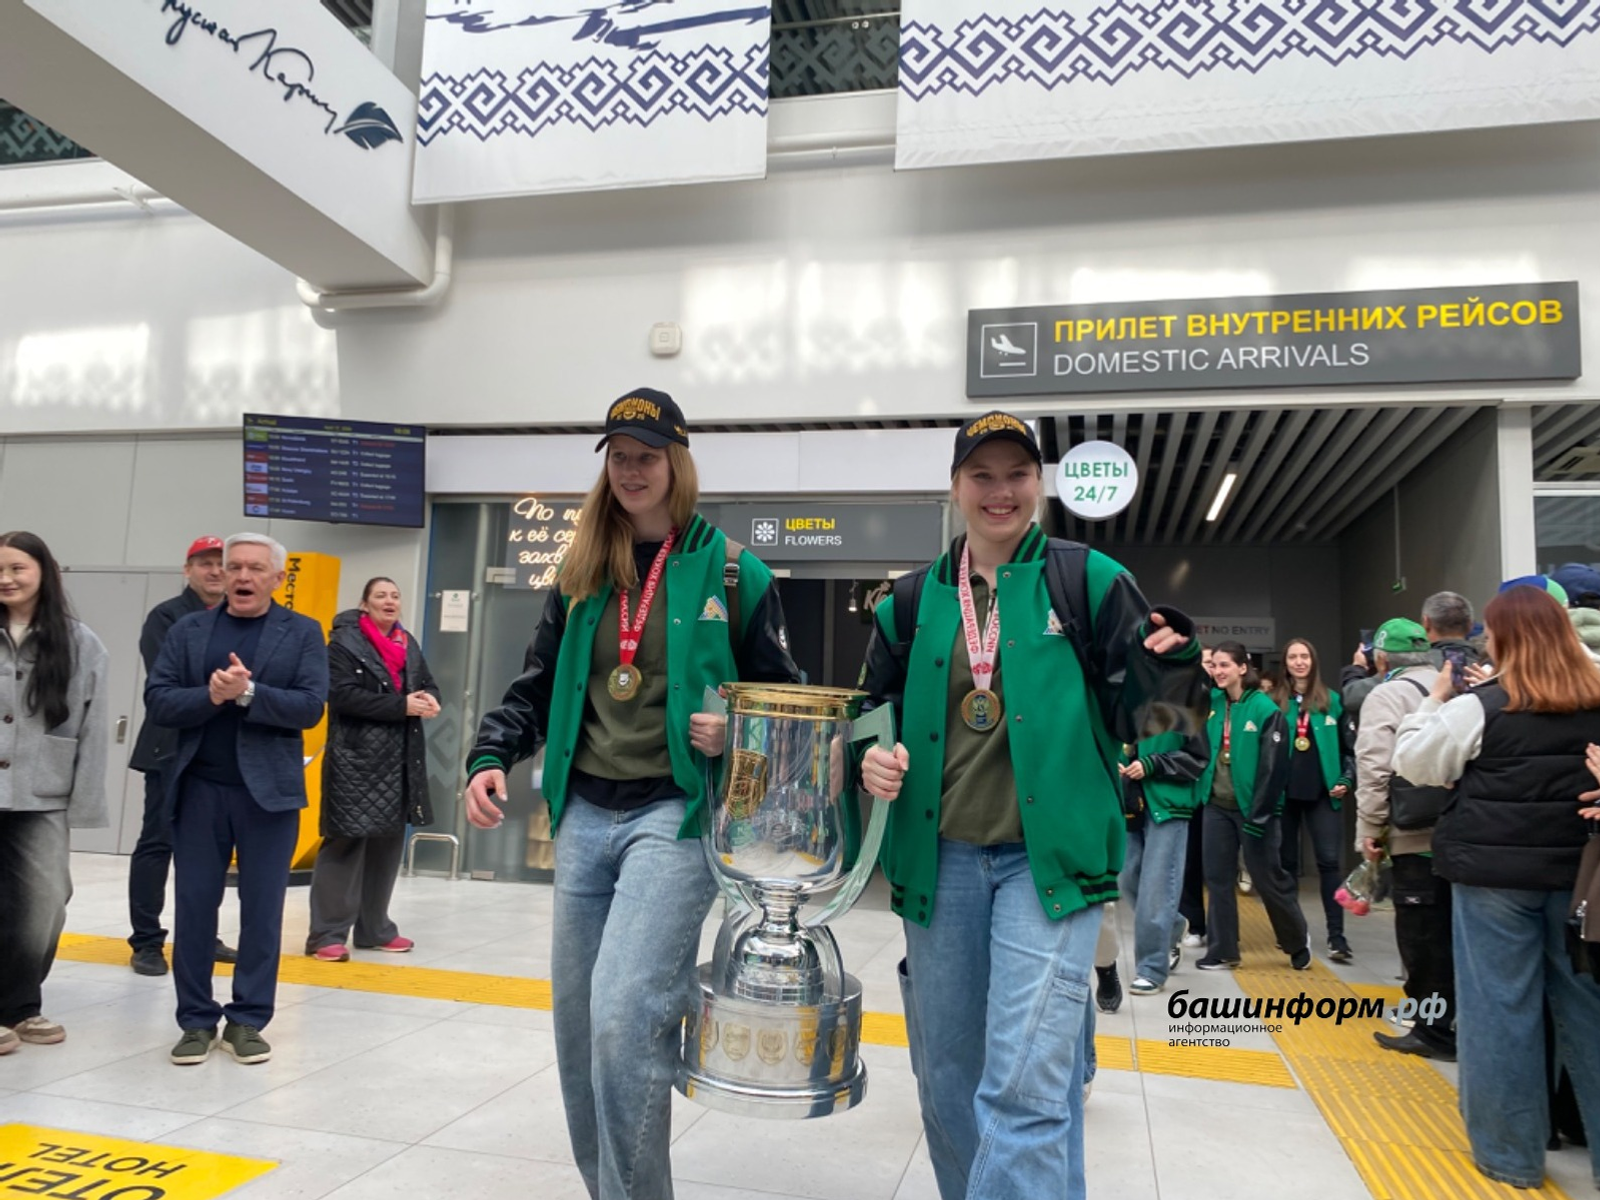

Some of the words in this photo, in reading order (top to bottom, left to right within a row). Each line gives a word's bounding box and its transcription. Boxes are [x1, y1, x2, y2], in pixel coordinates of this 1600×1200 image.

[1054, 315, 1178, 343] ПРИЛЕТ
[1186, 305, 1407, 337] ВНУТРЕННИХ
[1416, 296, 1564, 329] РЕЙСОВ
[1053, 348, 1210, 376] DOMESTIC
[1216, 342, 1370, 371] ARRIVALS
[1064, 462, 1128, 479] ЦВЕТЫ
[1073, 486, 1118, 504] 24/7
[514, 497, 554, 521] По
[785, 517, 836, 531] ЦВЕТЫ
[527, 526, 549, 543] её
[784, 535, 842, 546] FLOWERS
[518, 544, 568, 564] захв
[1231, 626, 1271, 635] ENTRY
[28, 1142, 187, 1179] HOTEL
[0, 1163, 167, 1200] ОТЕЛ
